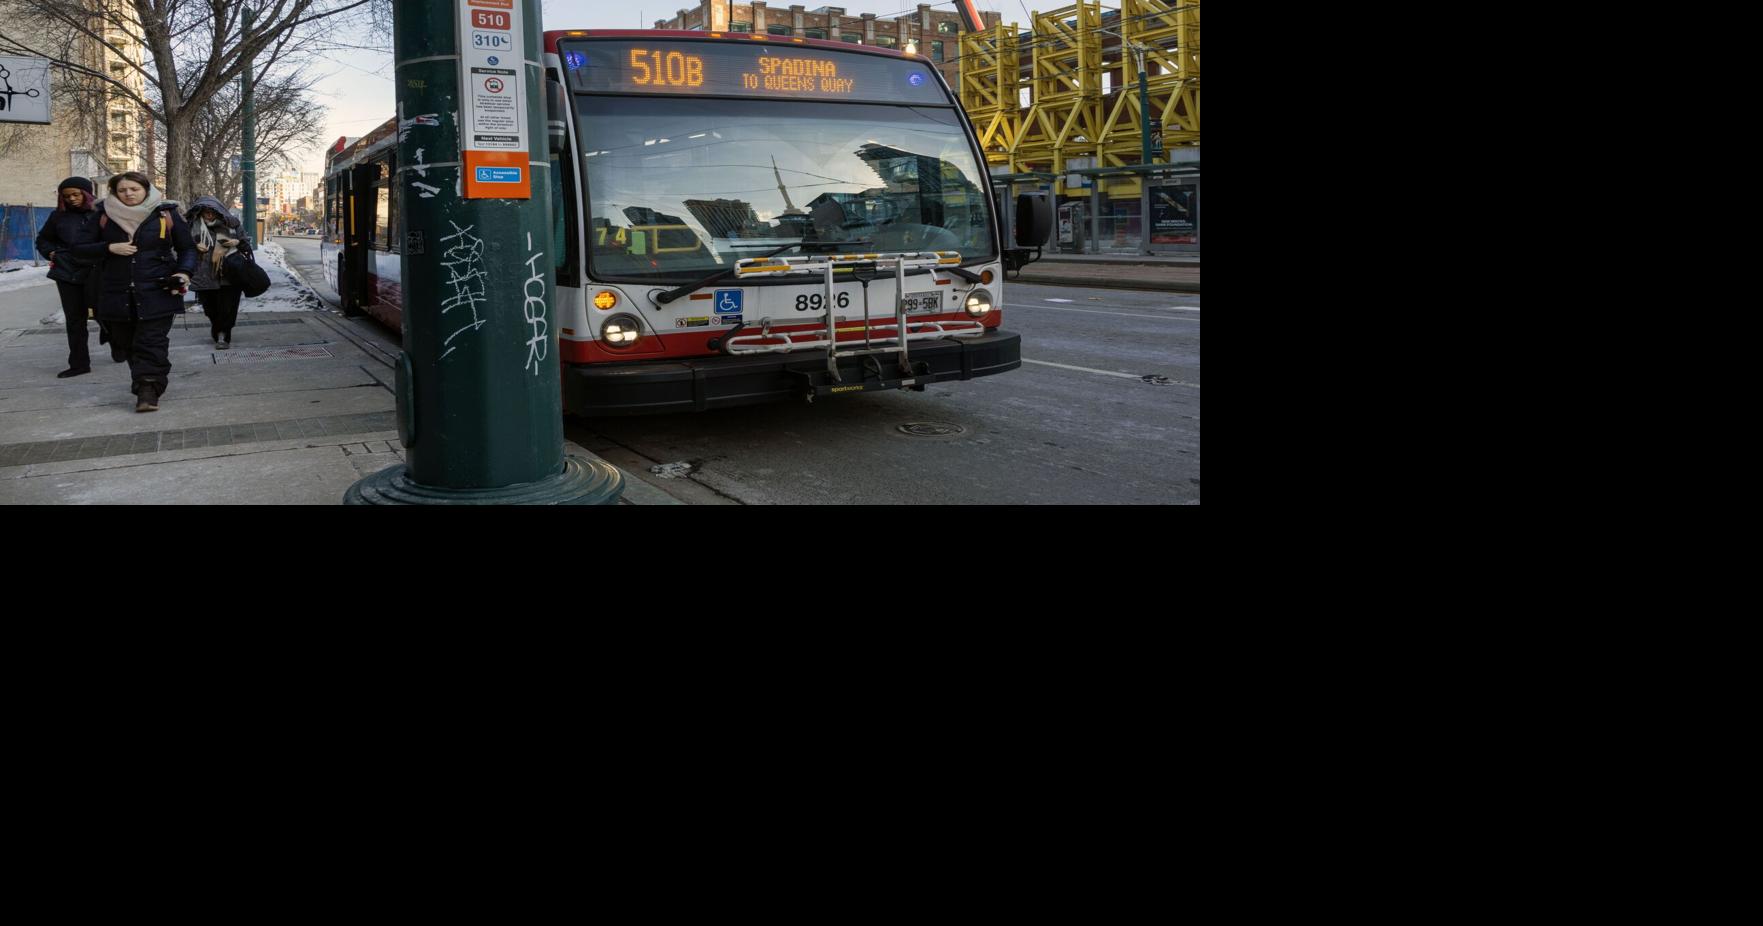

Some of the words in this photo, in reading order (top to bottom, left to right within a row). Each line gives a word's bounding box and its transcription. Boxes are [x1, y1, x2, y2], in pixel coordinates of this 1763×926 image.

[478, 13, 504, 26] 510
[475, 34, 500, 47] 310
[630, 48, 704, 87] 510B
[758, 57, 836, 77] SPADINA
[742, 73, 758, 89] TO
[764, 75, 815, 92] QUEENS
[821, 78, 854, 93] QUAY
